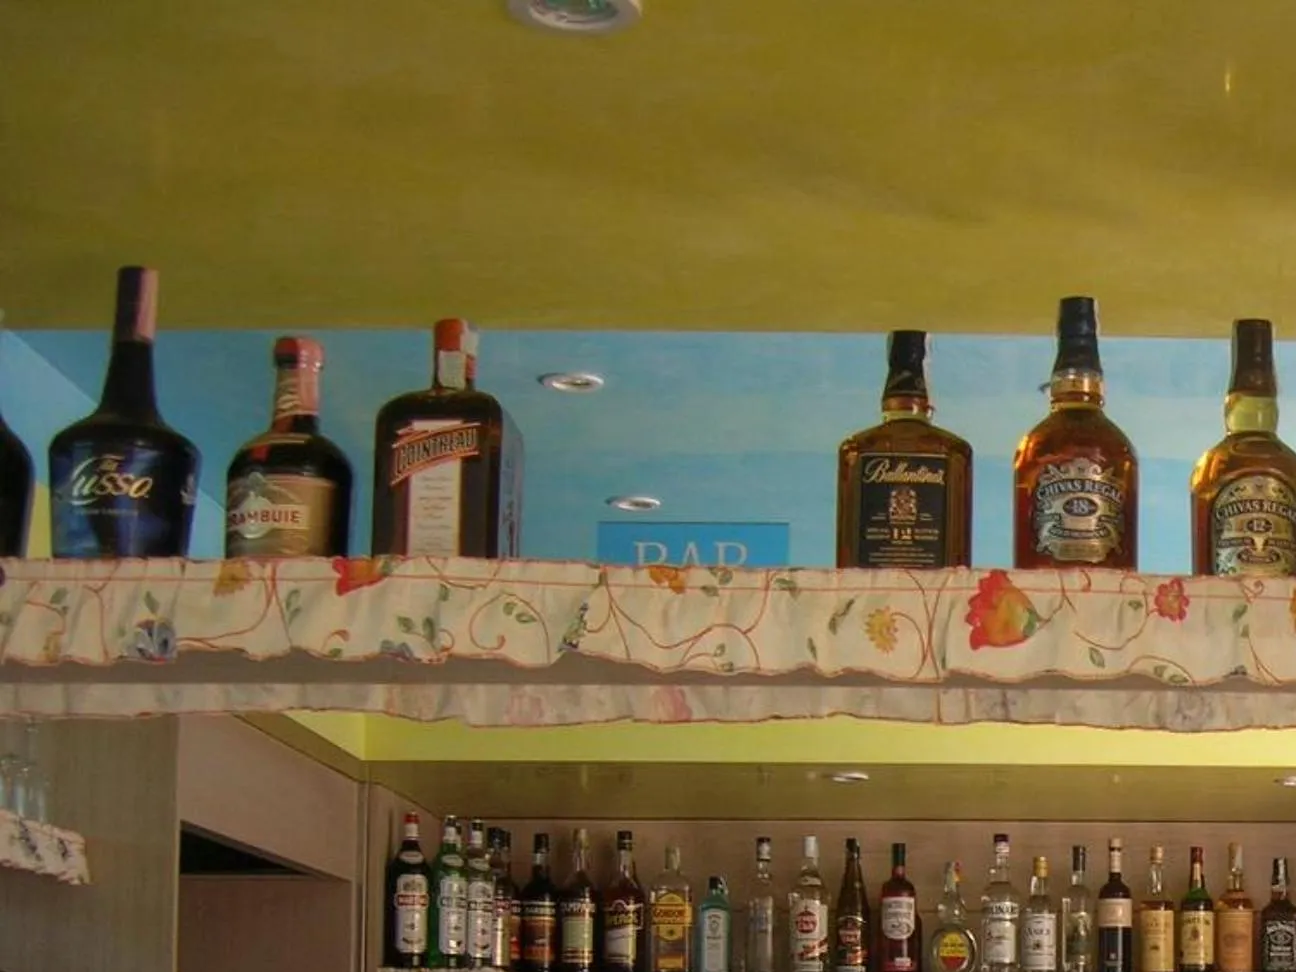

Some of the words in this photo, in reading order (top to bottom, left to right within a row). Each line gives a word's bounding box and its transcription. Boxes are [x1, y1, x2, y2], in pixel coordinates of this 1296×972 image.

[396, 428, 478, 474] COINTREAU
[1035, 479, 1082, 501] CHIVAS
[1083, 479, 1122, 503] REGAL
[1215, 499, 1261, 520] CHIVAS
